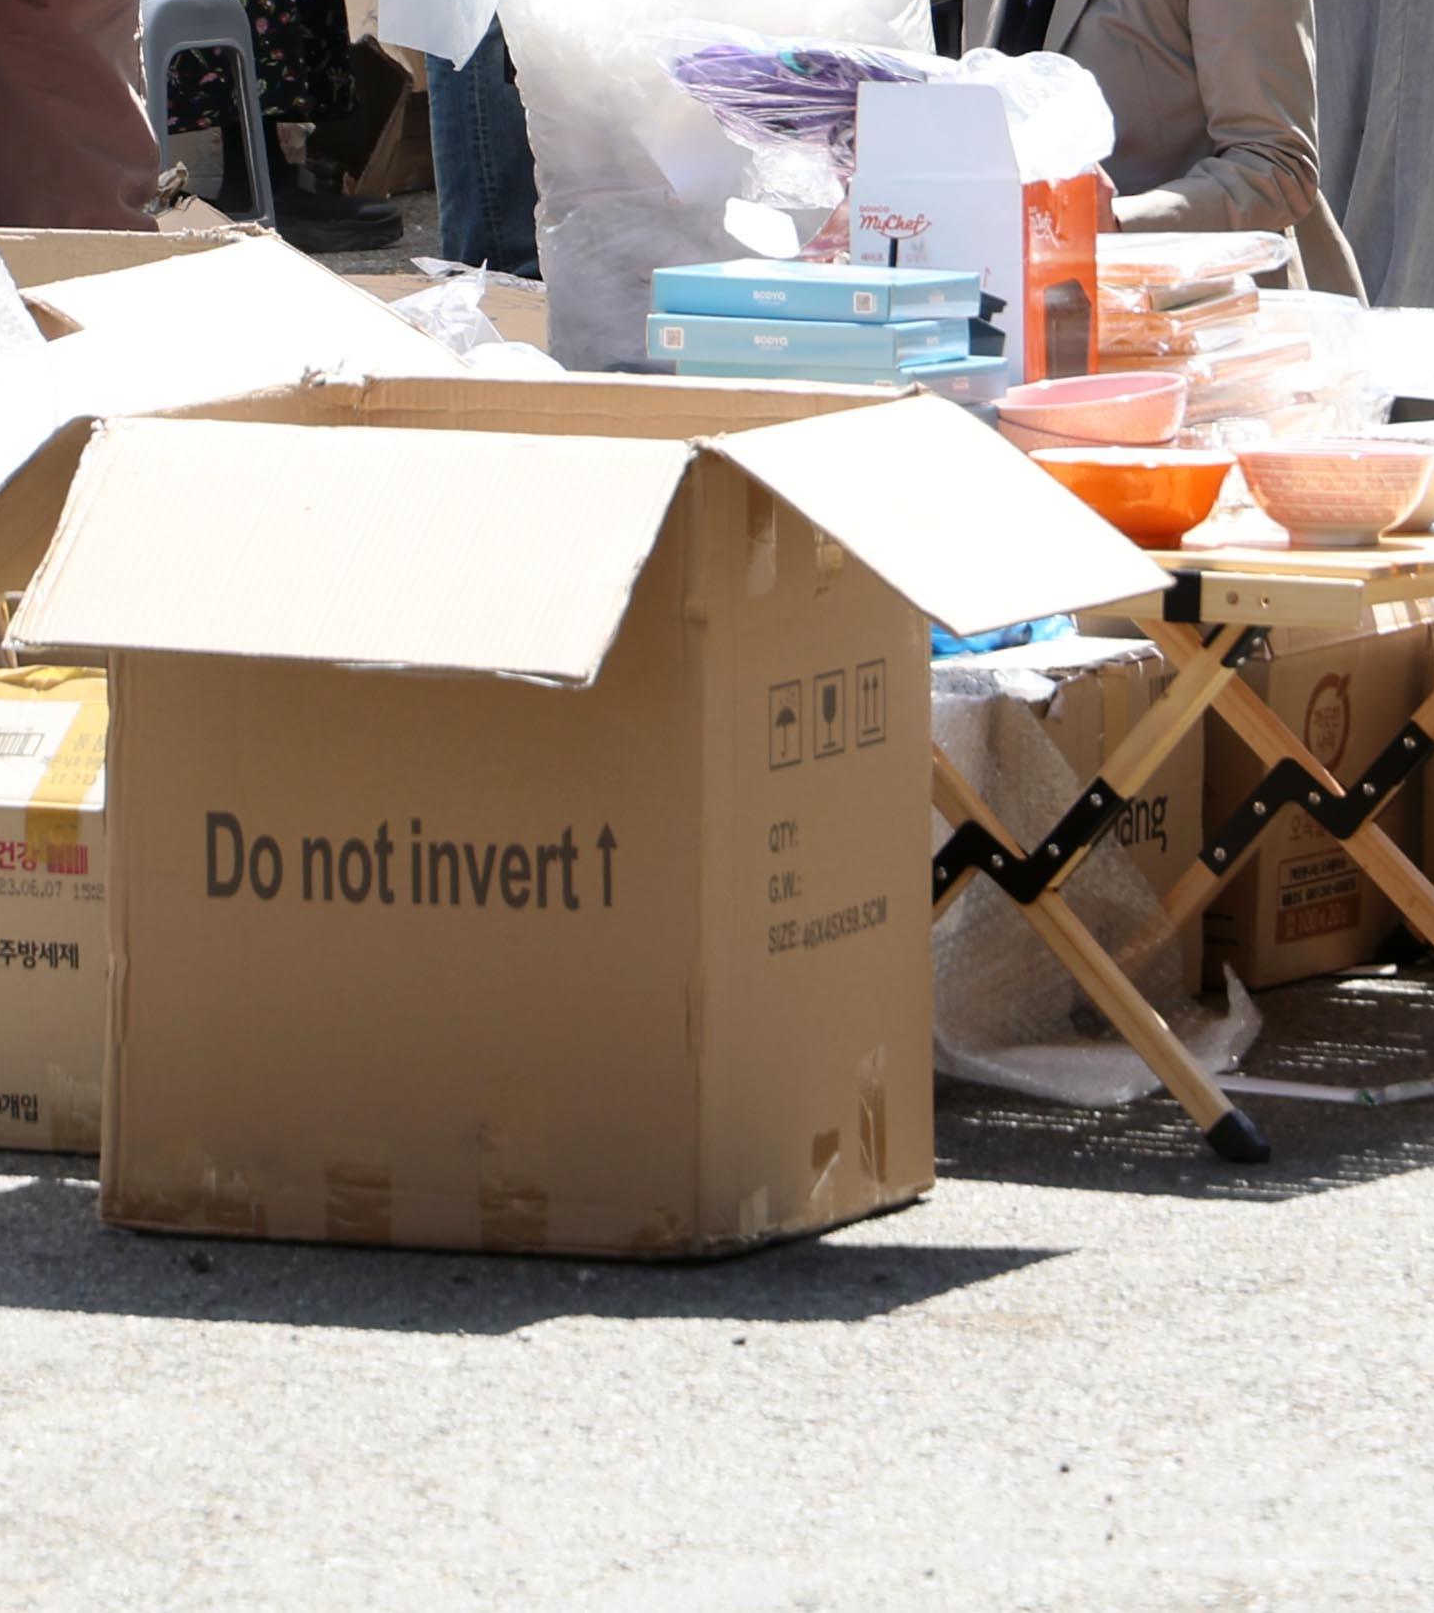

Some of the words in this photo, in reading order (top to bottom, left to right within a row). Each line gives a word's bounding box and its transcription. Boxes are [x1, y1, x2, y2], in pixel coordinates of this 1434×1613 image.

[859, 213, 929, 236] MyChef
[768, 818, 799, 853] QTY:
[204, 810, 284, 902] Do
[301, 819, 394, 905] not
[409, 818, 581, 912] invert
